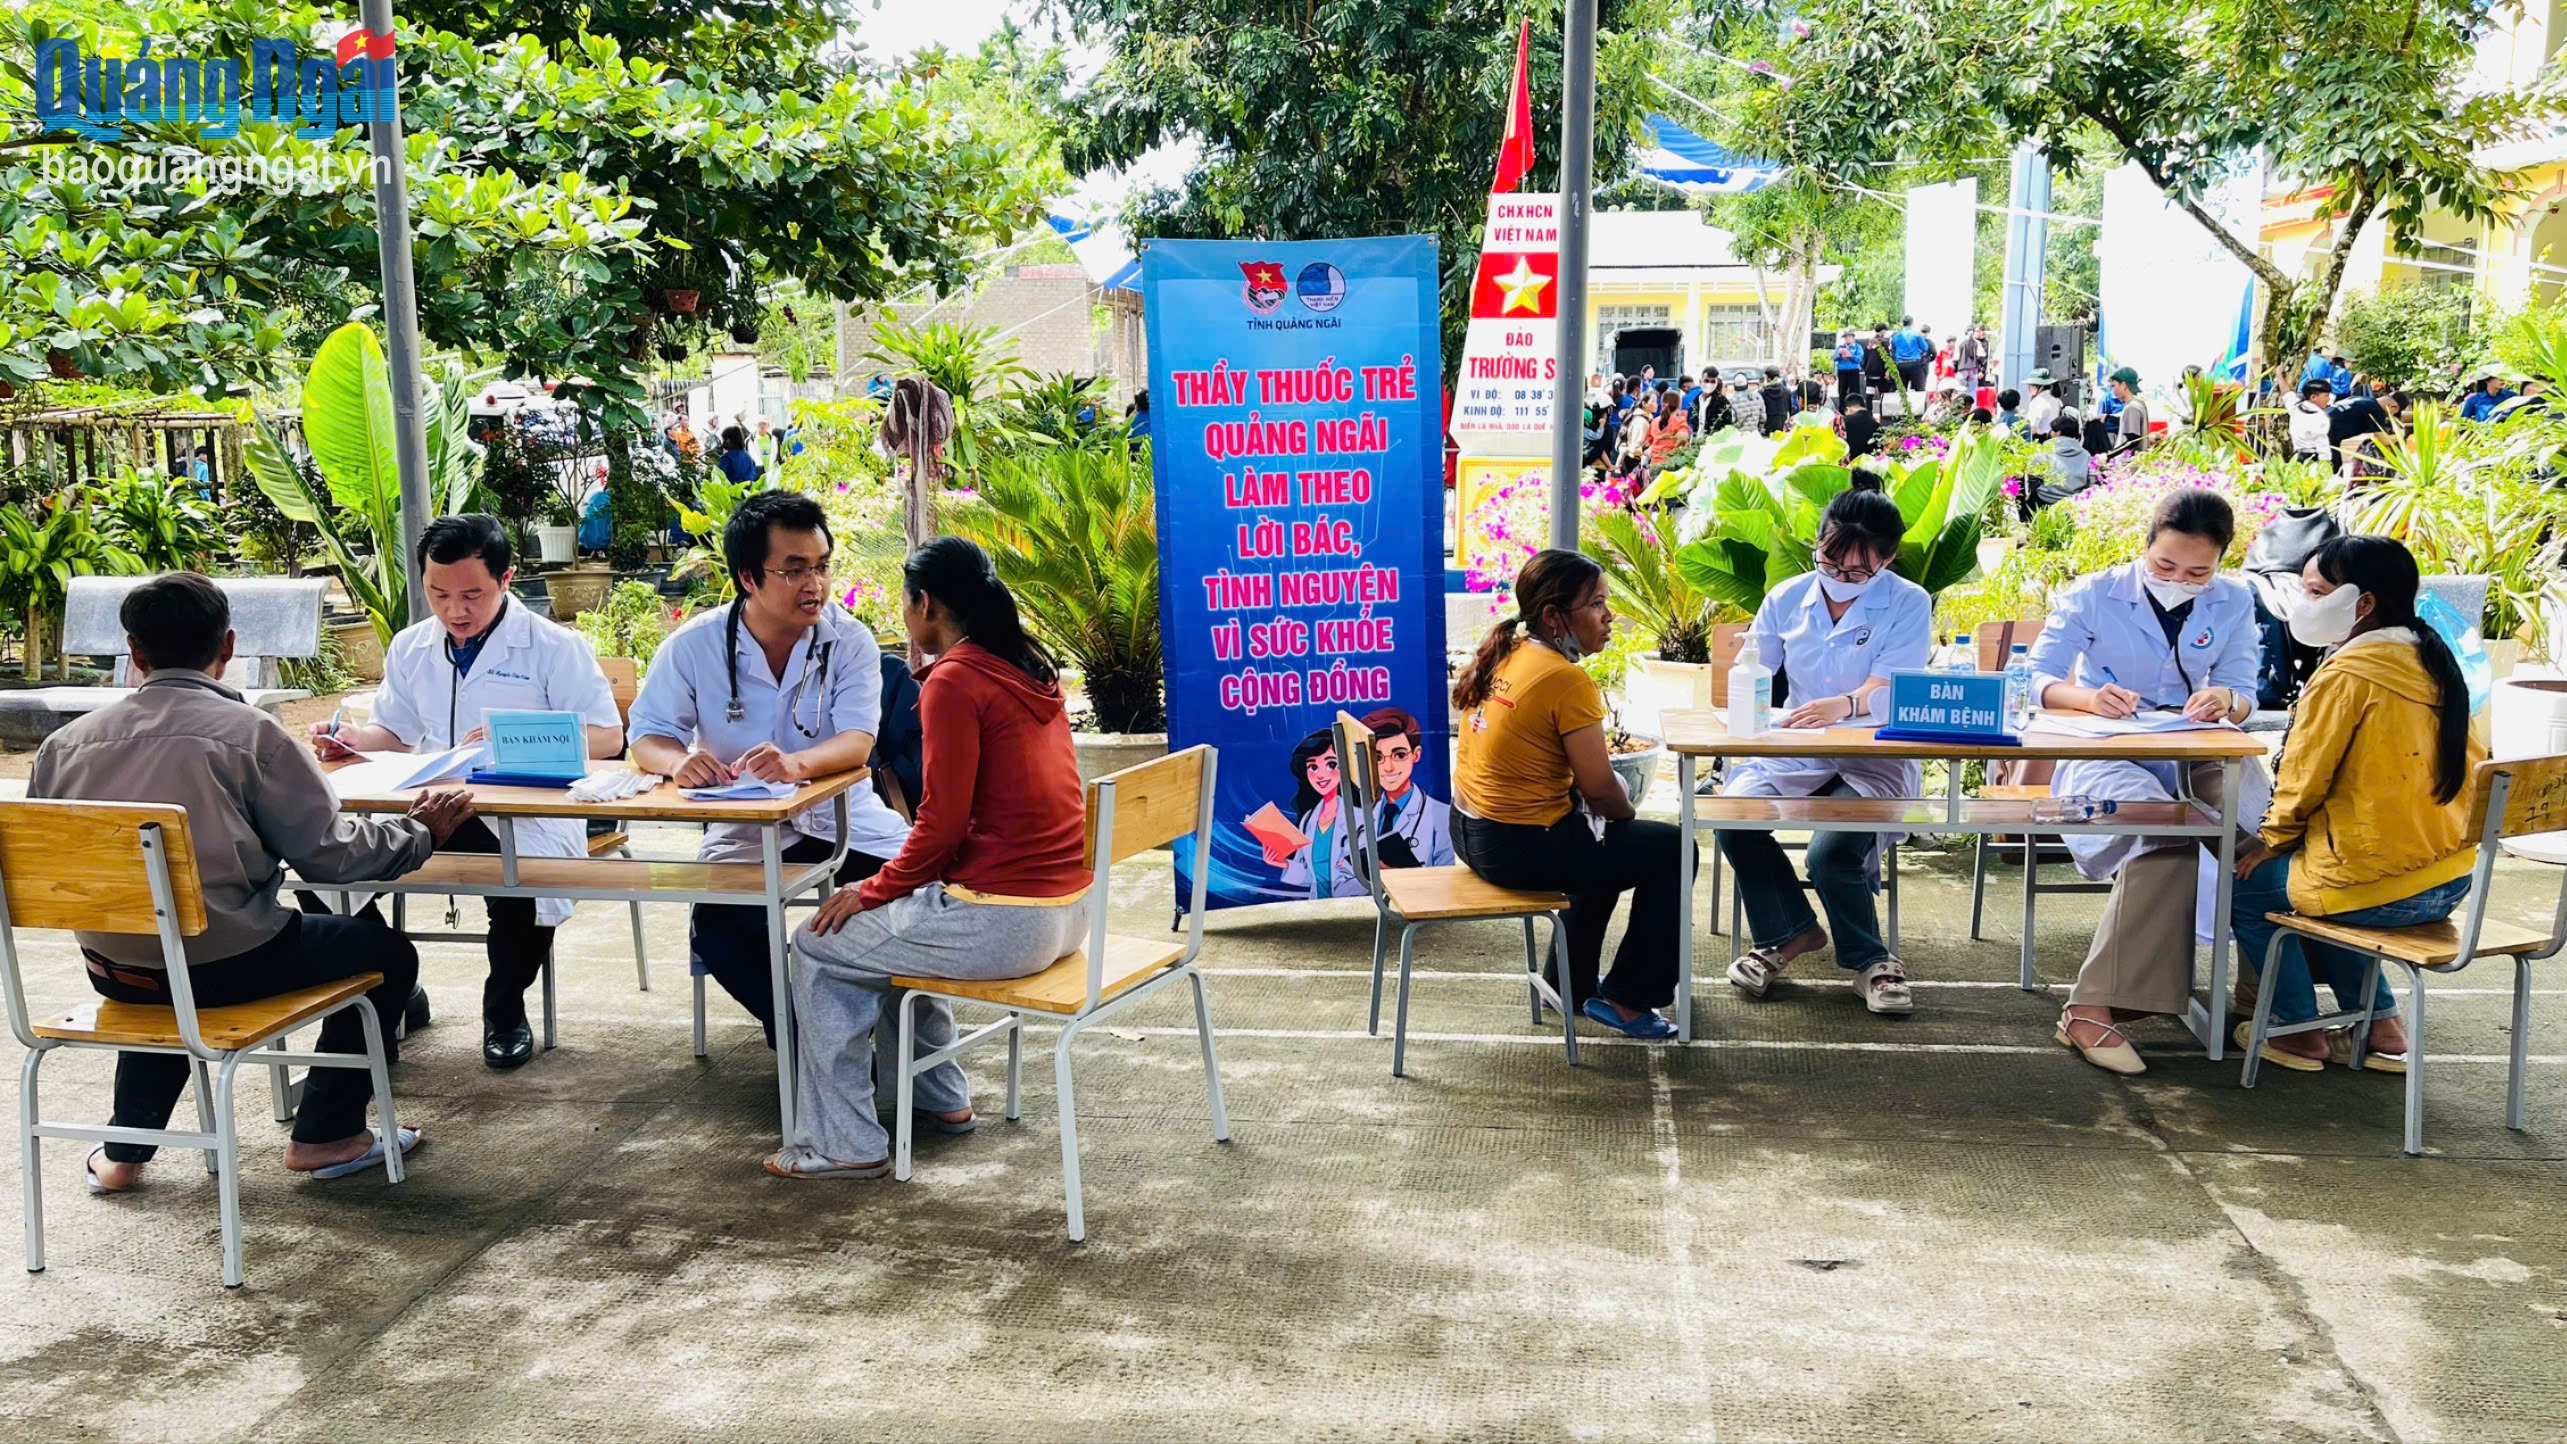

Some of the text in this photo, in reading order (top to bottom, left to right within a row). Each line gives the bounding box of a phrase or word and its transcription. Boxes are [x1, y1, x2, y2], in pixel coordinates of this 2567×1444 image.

[1498, 204, 1552, 218] CHXHCN
[1494, 225, 1557, 244] VIỆT NAM
[1247, 316, 1342, 331] TỈNH QUẢNG NGÃI
[1469, 351, 1556, 380] TRƯỜNG S
[1173, 355, 1416, 406] THẦY THUỐC TRẺ
[1464, 406, 1487, 415] KINH
[1205, 412, 1387, 461] QUẢNG NGÃI
[1224, 467, 1370, 508] LÀM THEO
[1238, 515, 1361, 558] LỜI BÁC,
[1204, 564, 1399, 610] TÌNH NGUYỆN
[1213, 609, 1394, 660] VÌ SỨC KHỎE
[1220, 659, 1390, 715] CỘNG ĐỒNG
[1930, 681, 1964, 701] BÀN
[1898, 703, 1995, 728] KHÁM BỆNH
[522, 734, 551, 744] KHÁM
[553, 734, 570, 745] NỘI
